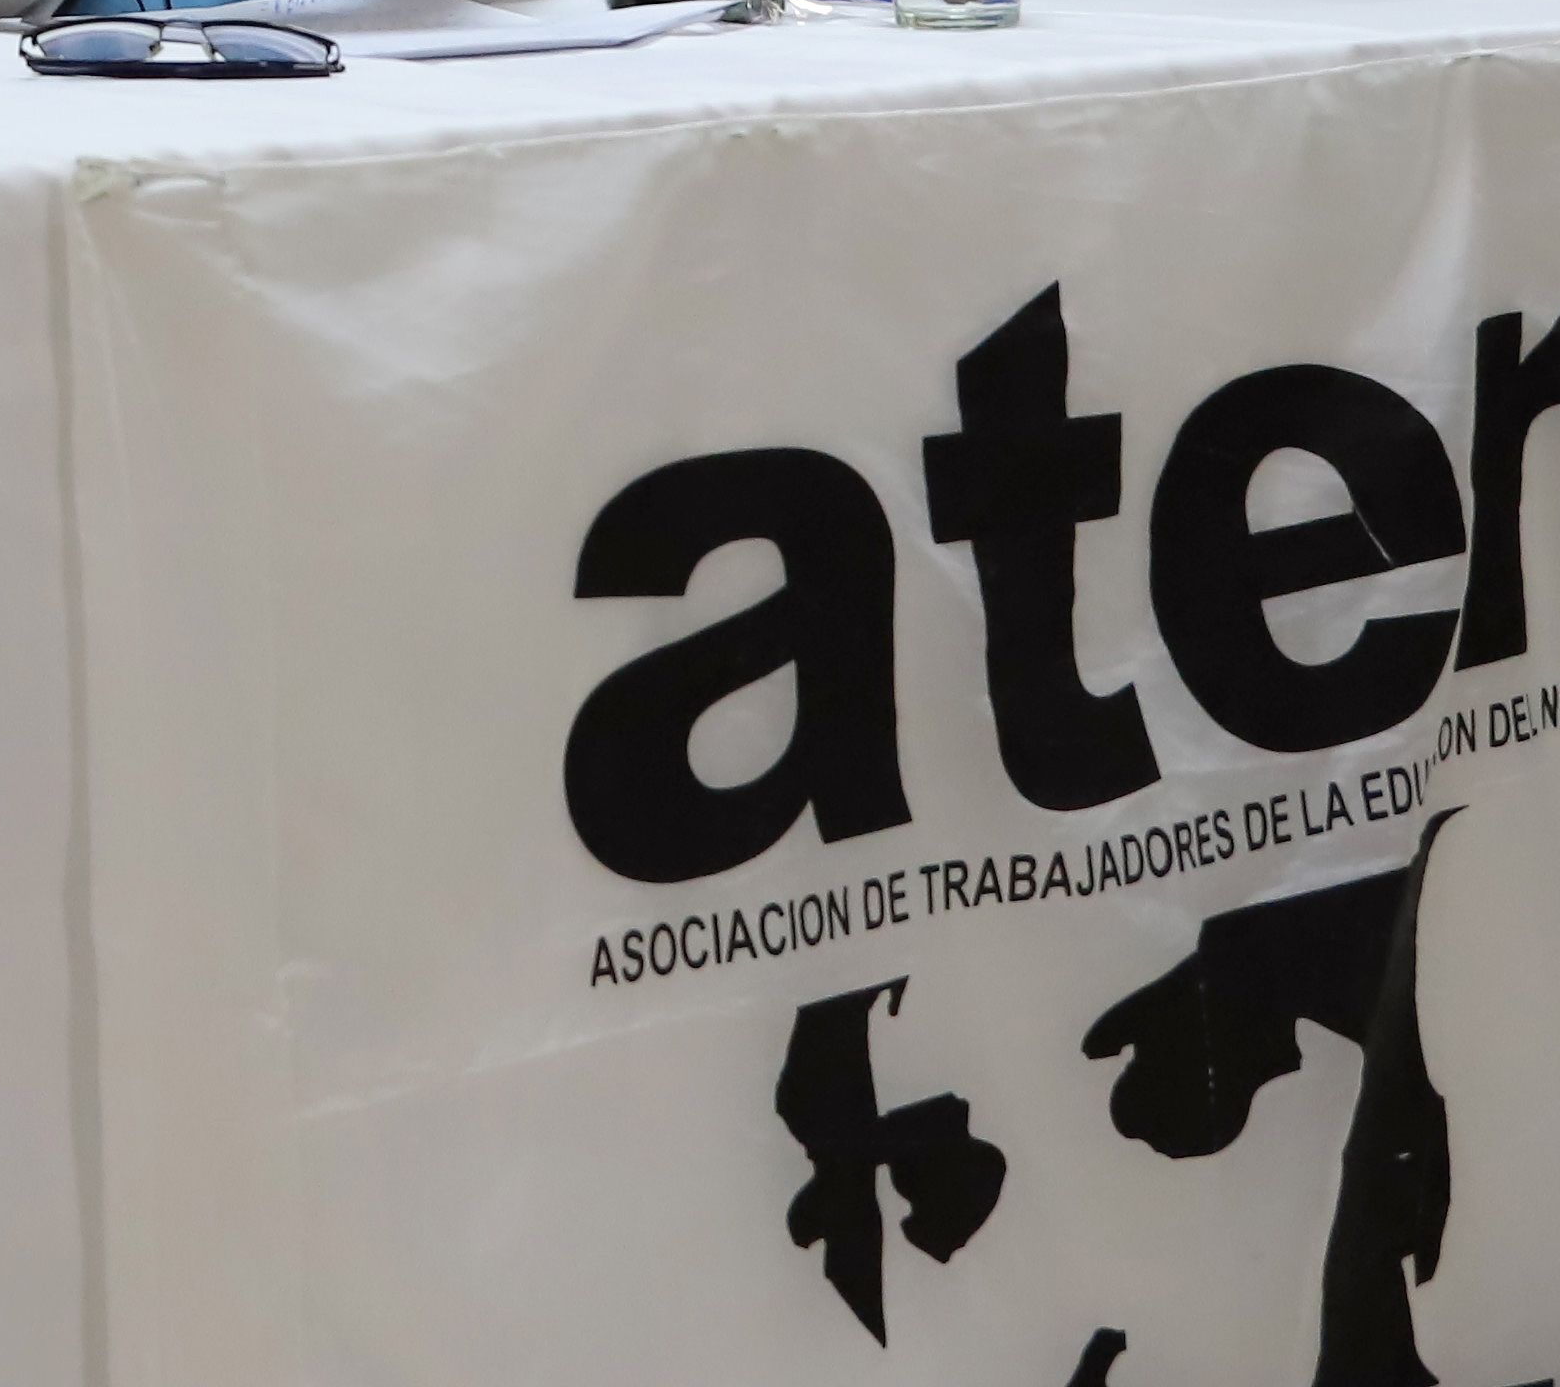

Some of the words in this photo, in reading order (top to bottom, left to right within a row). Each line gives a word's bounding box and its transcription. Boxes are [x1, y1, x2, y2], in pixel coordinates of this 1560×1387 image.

[590, 885, 851, 987] ASOCIACION
[863, 870, 909, 930] DE
[919, 809, 1235, 916] TRABAJADORES
[1242, 794, 1292, 852] DE
[1299, 780, 1355, 837] LA
